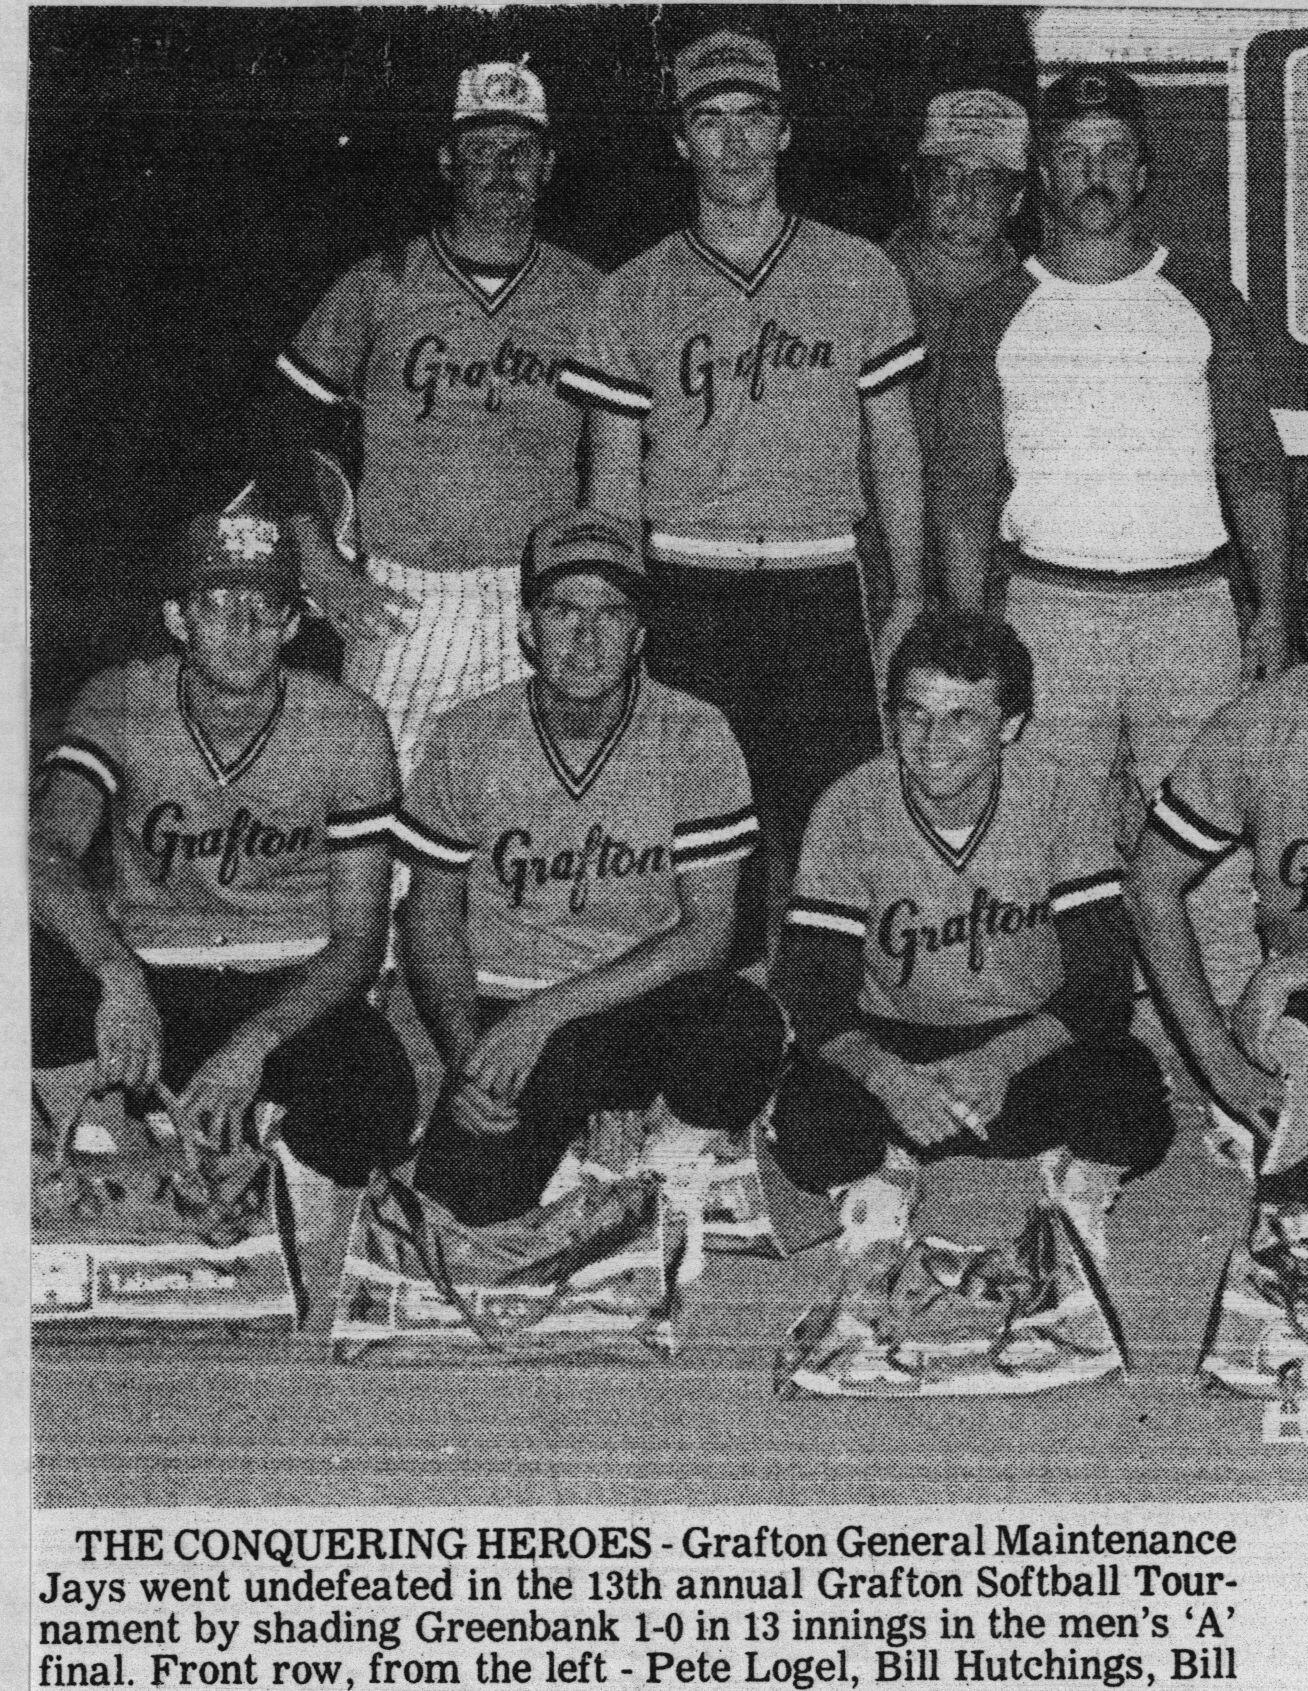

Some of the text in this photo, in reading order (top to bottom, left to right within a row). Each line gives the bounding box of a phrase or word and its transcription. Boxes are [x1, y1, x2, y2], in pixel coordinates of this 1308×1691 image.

[142, 801, 314, 886] Grafton
[491, 822, 666, 914] Grafton
[878, 886, 1051, 988] Grafton
[76, 1529, 163, 1561] THE
[174, 1528, 467, 1567] CONQUERING
[477, 1527, 651, 1560] HEROES
[683, 1526, 827, 1558] Grafton
[837, 1524, 985, 1557] General
[995, 1523, 1236, 1555] Maintenance
[39, 1564, 1237, 1611] Jays went undefeated in the 13th annual Grafton Softball Tour-
[40, 1607, 1234, 1651] nament by shading Greenbank 1-0 in 13 innings in the men's 'A'
[39, 1653, 135, 1687] final.
[151, 1654, 257, 1686] Front
[273, 1662, 354, 1690] row,
[370, 1652, 460, 1684] from
[476, 1652, 531, 1684] the
[546, 1651, 607, 1683] left
[647, 1652, 730, 1683] Pete
[746, 1650, 858, 1690] Logel,
[876, 1649, 939, 1681] Bill
[955, 1648, 1154, 1687] Hutchings,
[1171, 1647, 1236, 1679] Bill
